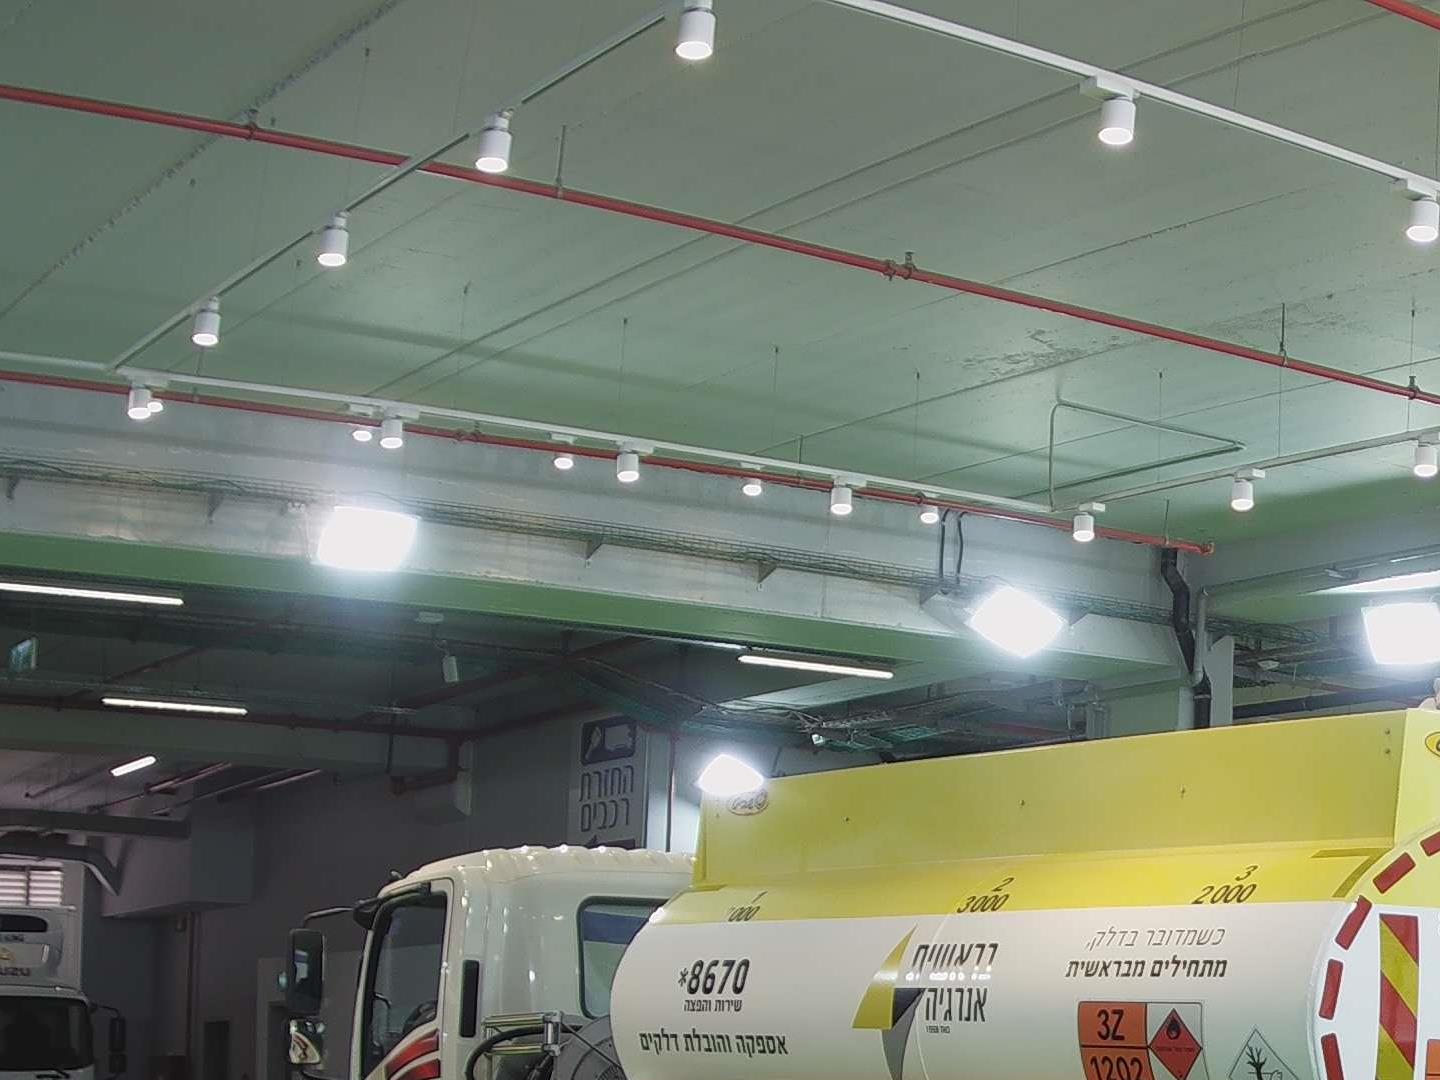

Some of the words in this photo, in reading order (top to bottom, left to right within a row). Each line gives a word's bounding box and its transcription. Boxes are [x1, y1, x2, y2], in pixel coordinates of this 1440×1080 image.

[581, 798, 630, 832] רכבים
[1235, 865, 1258, 881] 3
[992, 877, 1015, 892] 2
[1192, 884, 1257, 905] 2000
[727, 905, 760, 922] 000
[956, 894, 1010, 914] 3000
[1147, 928, 1226, 946] כשמדובר
[1065, 959, 1146, 978] מבראשית
[1150, 955, 1228, 978] מתחילים
[684, 1000, 712, 1012] והפצה
[714, 1000, 743, 1012] שירות
[925, 988, 988, 1022] אנרגיה
[1097, 1009, 1125, 1041] 3Z
[638, 1028, 679, 1055] דלקים
[684, 1028, 733, 1054] והובלת
[736, 1034, 789, 1057] אספקה
